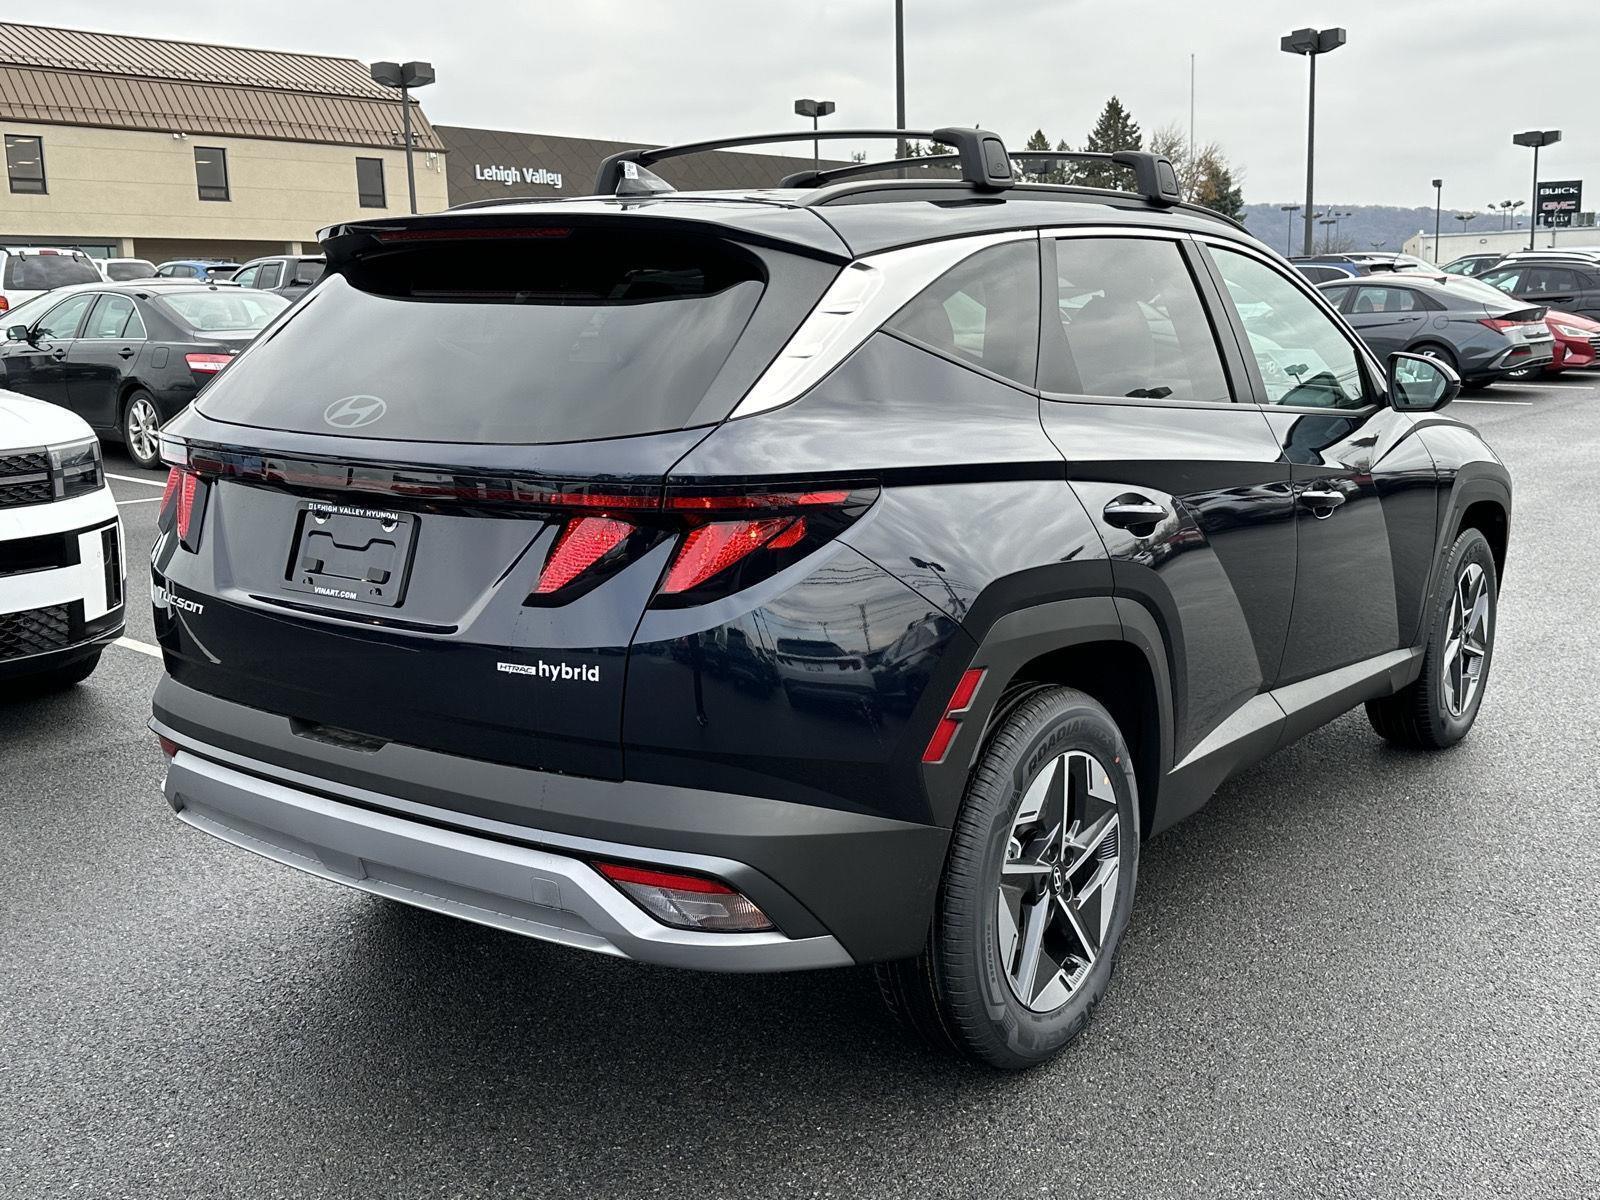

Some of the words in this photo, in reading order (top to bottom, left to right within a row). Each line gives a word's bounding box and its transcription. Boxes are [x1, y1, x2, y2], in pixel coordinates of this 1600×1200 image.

[475, 164, 521, 186] Lehigh
[521, 167, 563, 189] Valley
[1540, 186, 1579, 195] BUICK
[1542, 200, 1576, 211] GMC
[313, 503, 338, 513] LEHIGH
[339, 506, 365, 516] VALLEY
[366, 509, 399, 520] HYUNDAI
[314, 586, 358, 600] VINART.COM
[498, 662, 535, 675] HTRAC
[538, 660, 600, 682] hybrid
